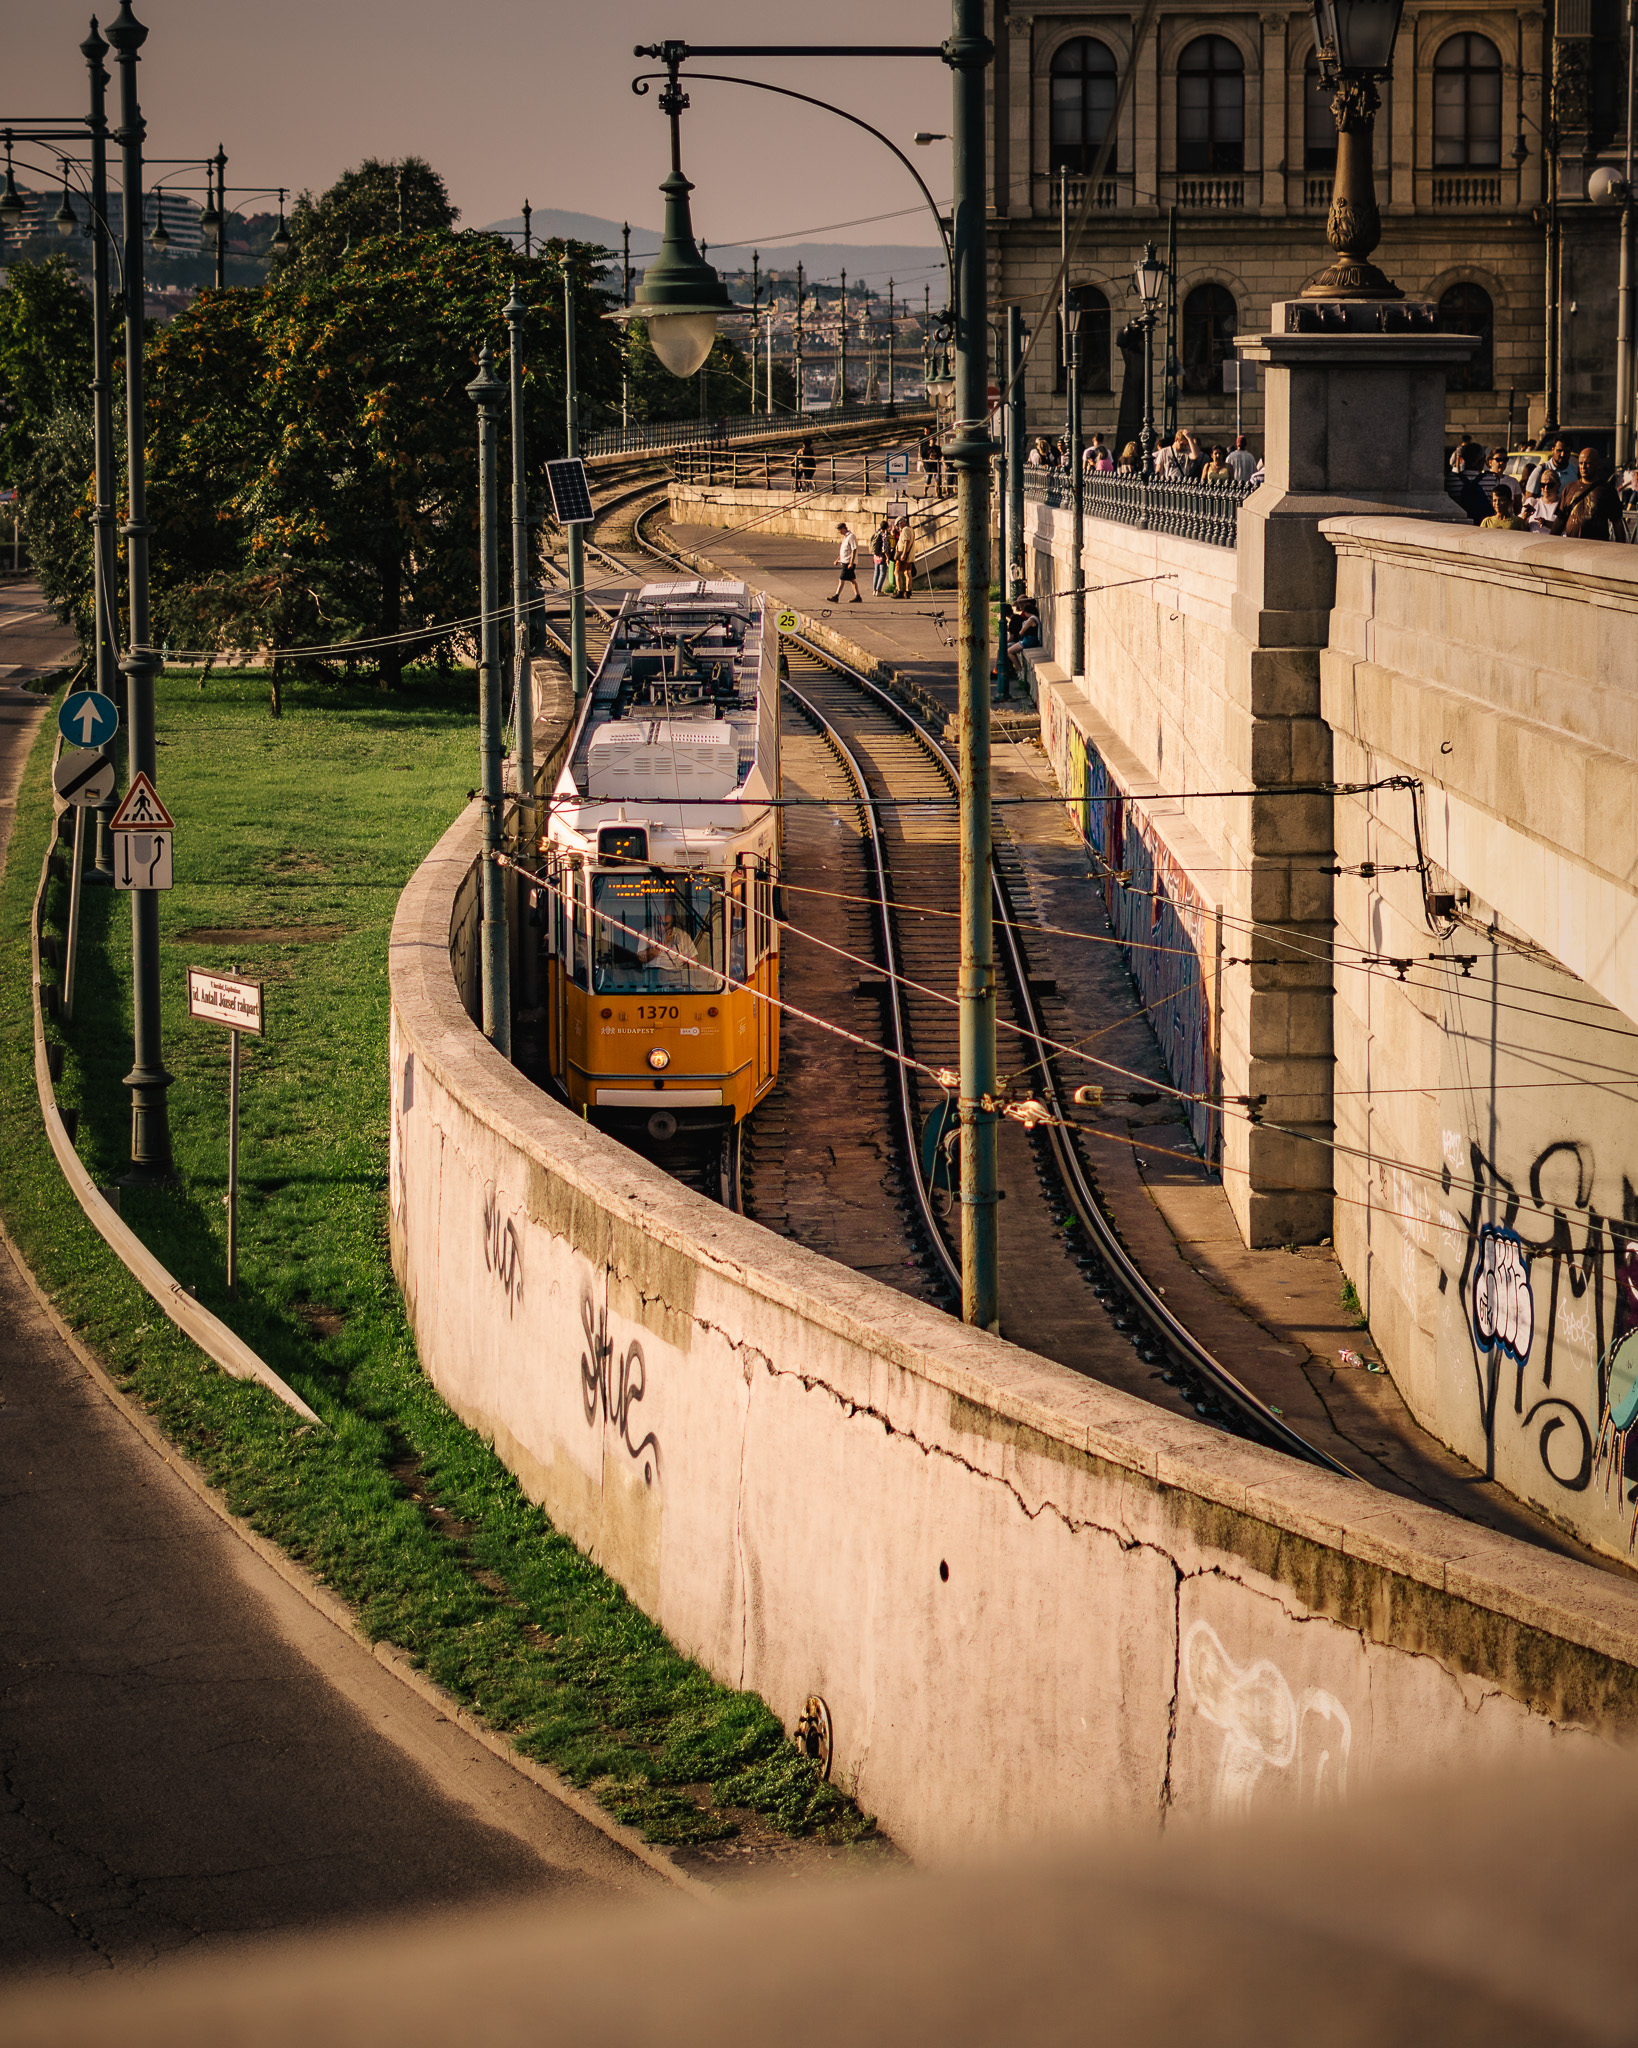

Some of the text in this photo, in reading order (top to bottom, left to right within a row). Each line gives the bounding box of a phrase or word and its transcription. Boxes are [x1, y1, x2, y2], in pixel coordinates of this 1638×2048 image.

[780, 615, 795, 627] 25
[201, 988, 218, 1006] Antall
[219, 993, 237, 1011] József
[237, 998, 260, 1016] rakpart
[637, 1005, 679, 1019] 1370
